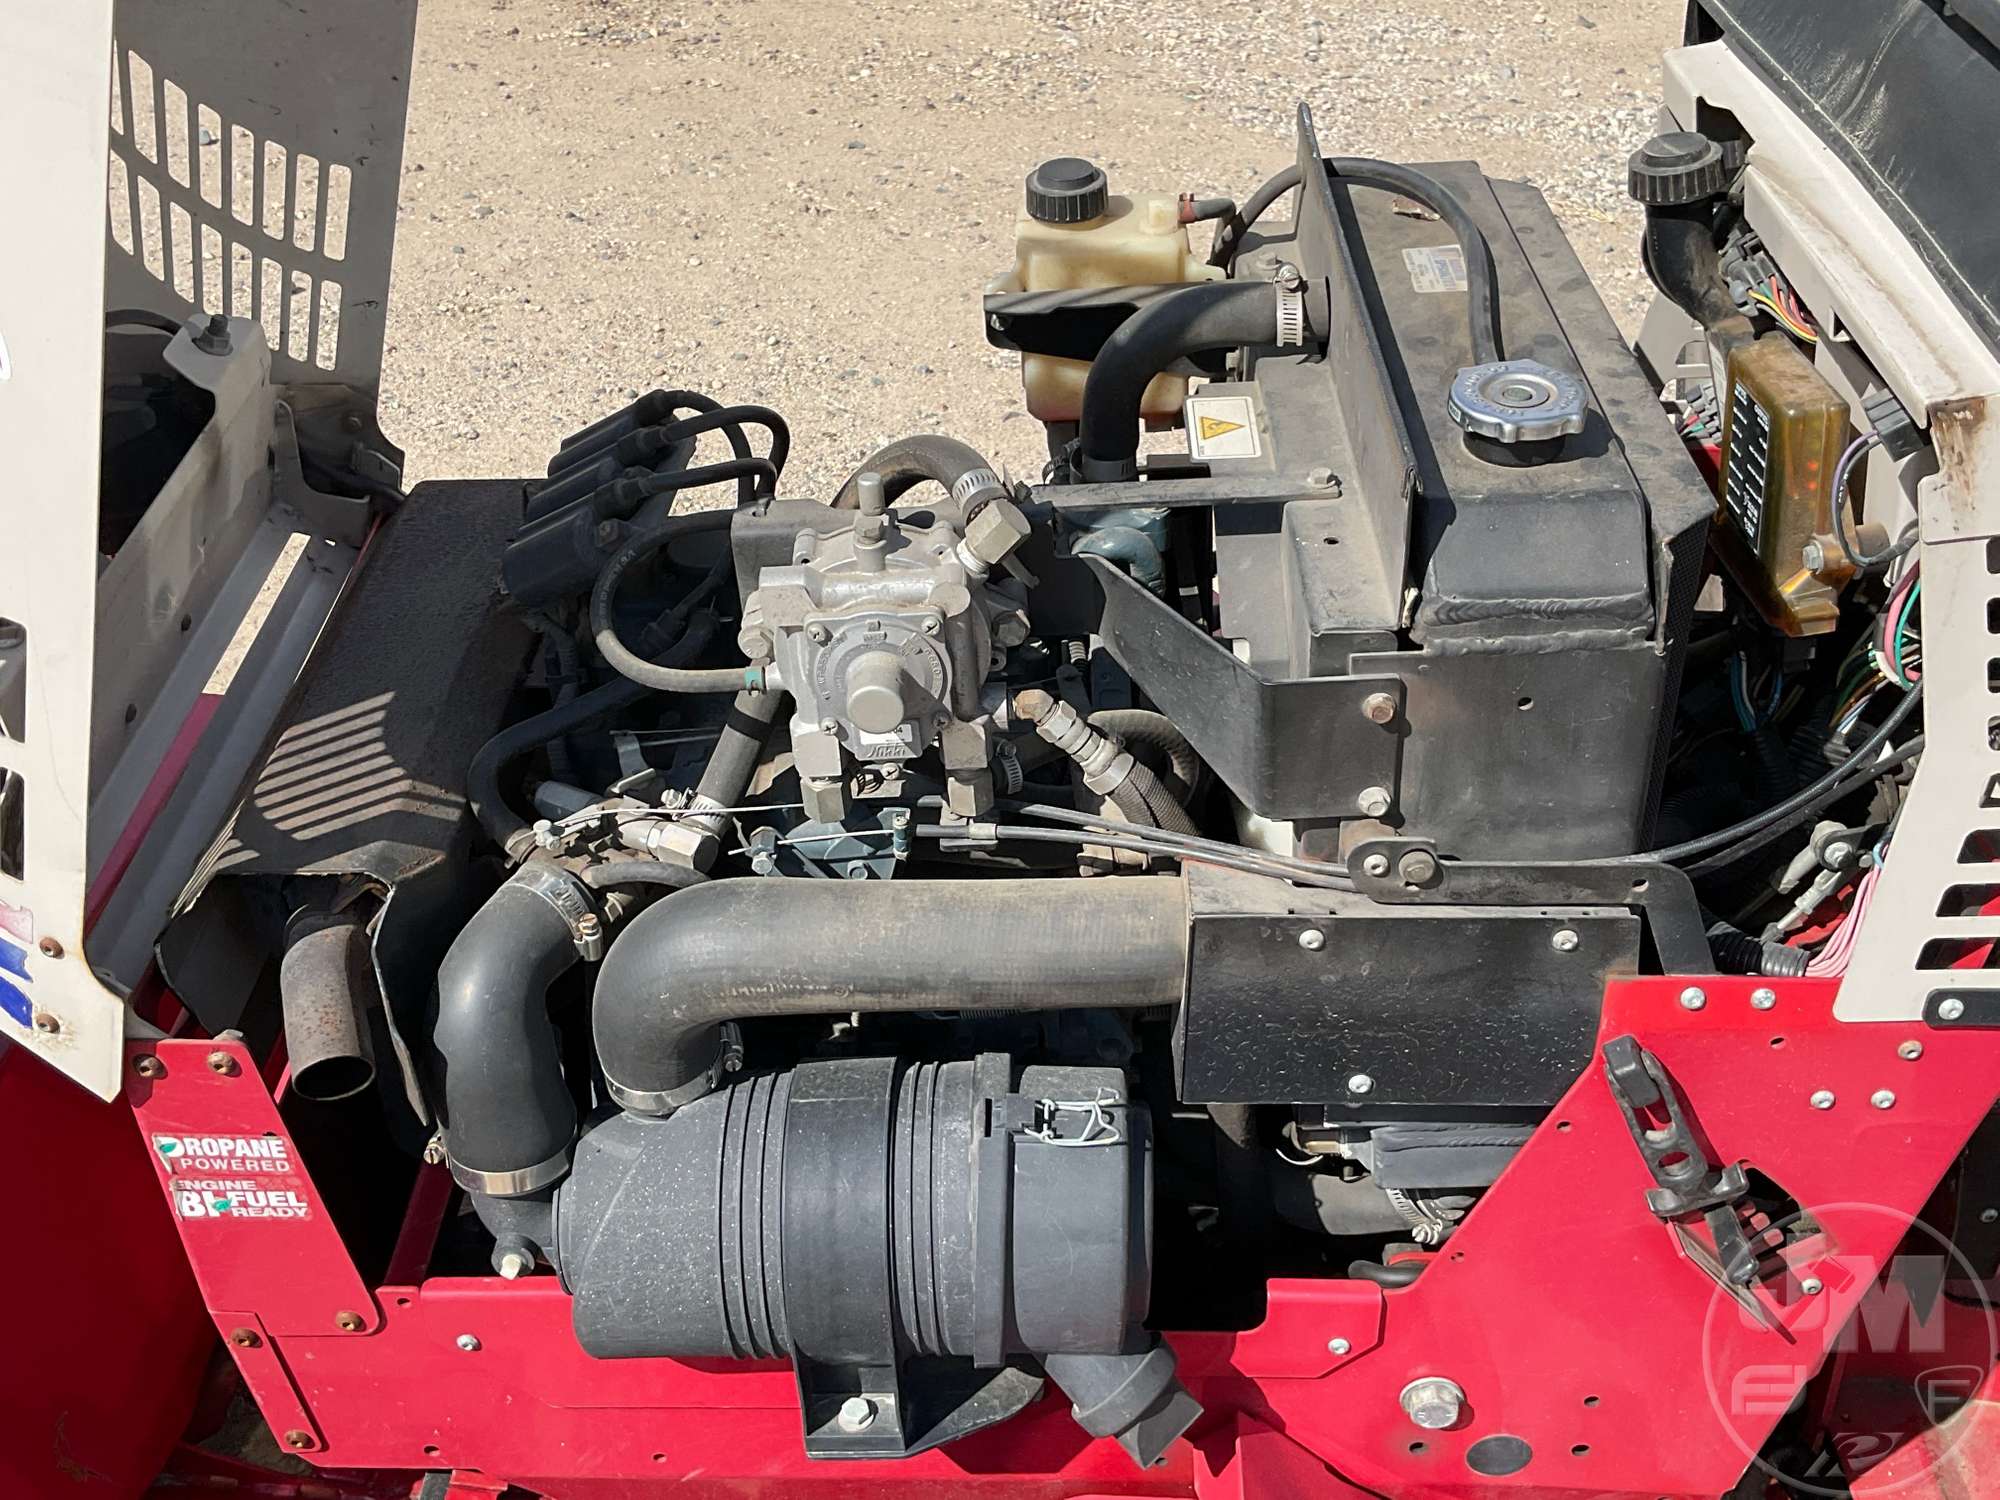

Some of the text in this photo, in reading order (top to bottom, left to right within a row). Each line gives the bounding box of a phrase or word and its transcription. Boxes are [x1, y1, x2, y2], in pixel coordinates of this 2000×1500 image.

[180, 1157, 291, 1173] POWERED
[176, 1179, 258, 1192] ENGINE
[231, 1207, 309, 1218] READY
